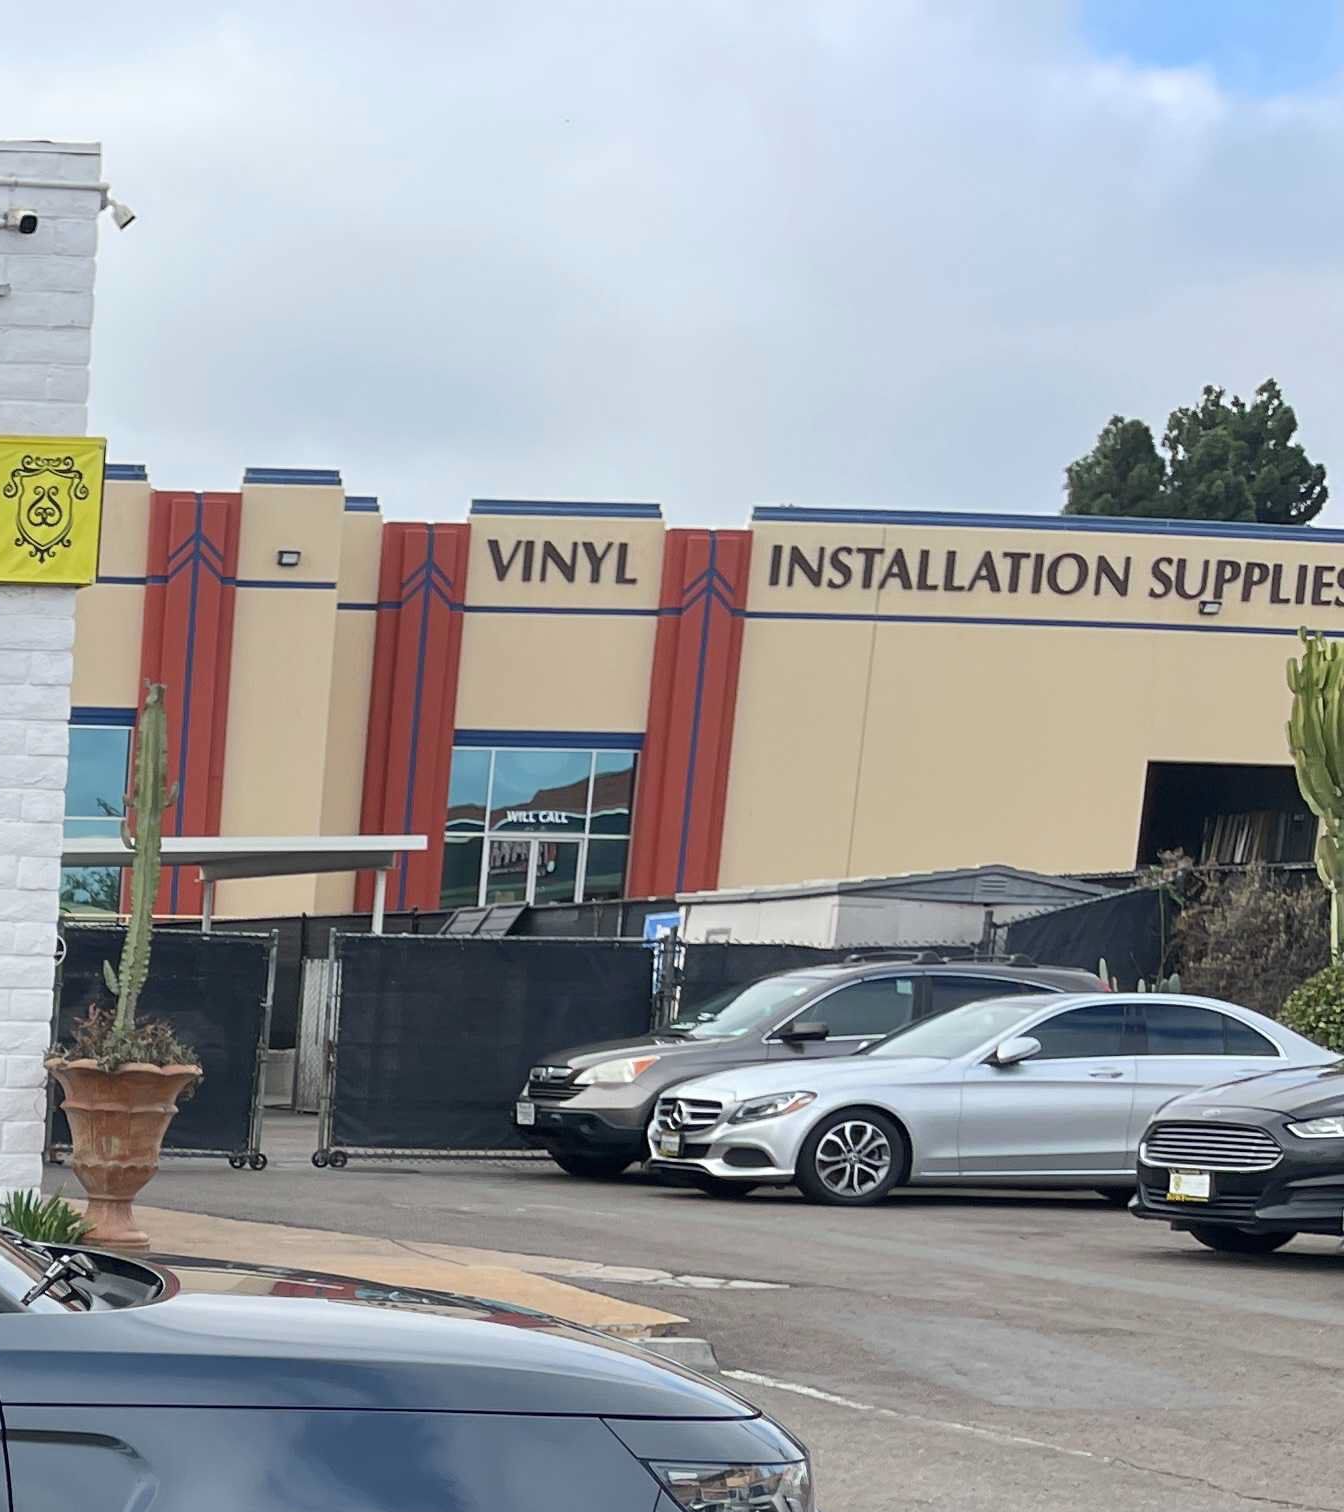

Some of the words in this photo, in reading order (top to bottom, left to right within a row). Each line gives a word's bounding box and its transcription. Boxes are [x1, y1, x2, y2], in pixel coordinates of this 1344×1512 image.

[488, 538, 637, 586] VINYL
[768, 544, 1131, 597] INSTALLATION
[507, 810, 537, 823] WILL
[539, 811, 568, 823] CALL
